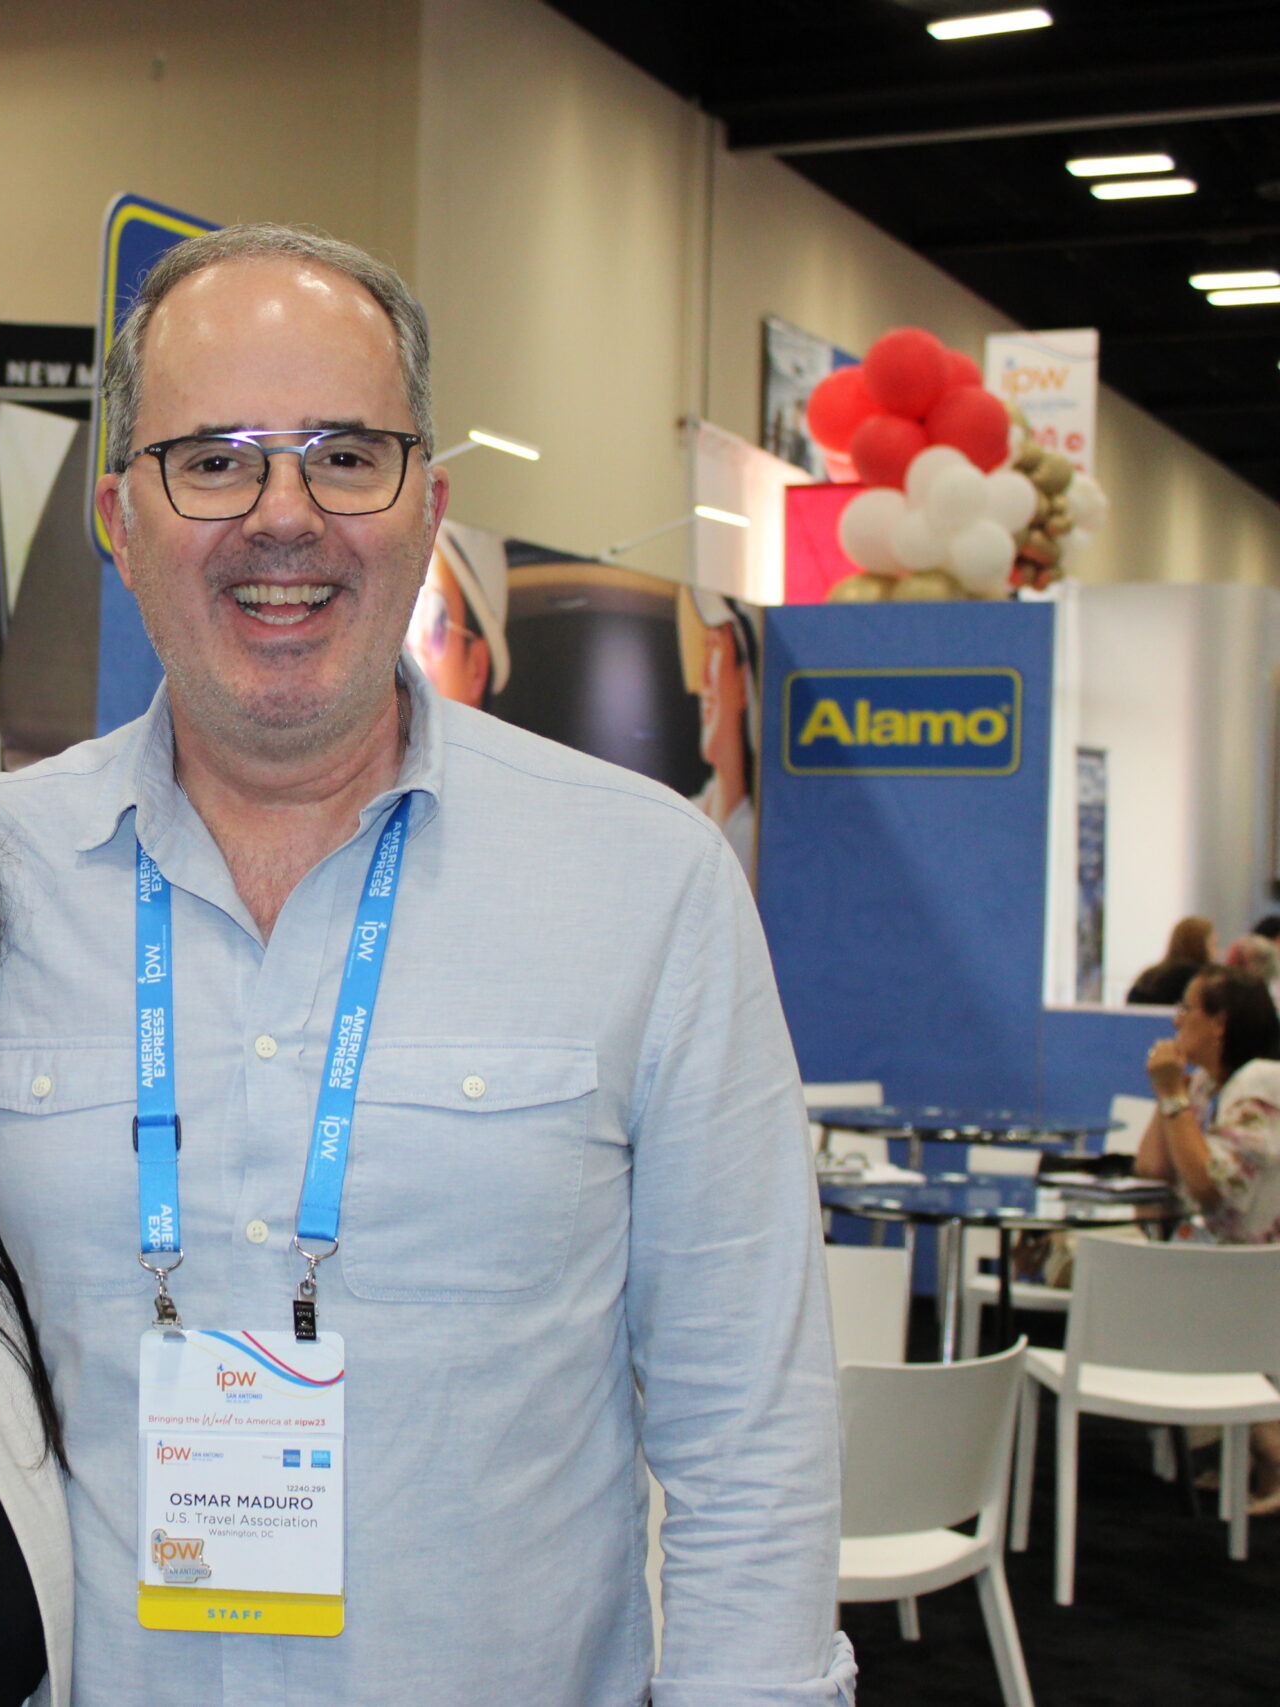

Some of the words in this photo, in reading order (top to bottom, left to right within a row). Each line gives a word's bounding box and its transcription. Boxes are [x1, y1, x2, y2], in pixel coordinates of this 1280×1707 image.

[6, 360, 71, 386] NEW
[1001, 359, 1069, 400] ipw
[798, 698, 1008, 746] Alamo
[369, 831, 391, 897] EXPRESS
[379, 821, 402, 898] AMERICAN
[357, 921, 387, 962] ipw
[138, 945, 167, 984] ipw
[140, 1008, 154, 1088] AMERICAN
[153, 1007, 166, 1077] EXPRESS
[328, 1014, 354, 1088] EXPRESS
[340, 1005, 368, 1090] AMERICAN
[319, 1115, 350, 1162] ipw
[216, 1364, 257, 1392] ipw
[148, 1415, 183, 1425] Bringing
[186, 1415, 200, 1424] the
[235, 1417, 243, 1425] to
[246, 1417, 281, 1425] America
[156, 1441, 191, 1464] ipw
[165, 1511, 190, 1524] U.S.
[195, 1512, 236, 1525] Travel
[240, 1514, 319, 1528] Association
[170, 1492, 231, 1507] OSMAR
[237, 1495, 314, 1510] MADURO
[154, 1533, 201, 1567] ipw
[209, 1528, 258, 1538] Washington,
[261, 1529, 275, 1538] DC
[207, 1608, 263, 1620] STAFF
